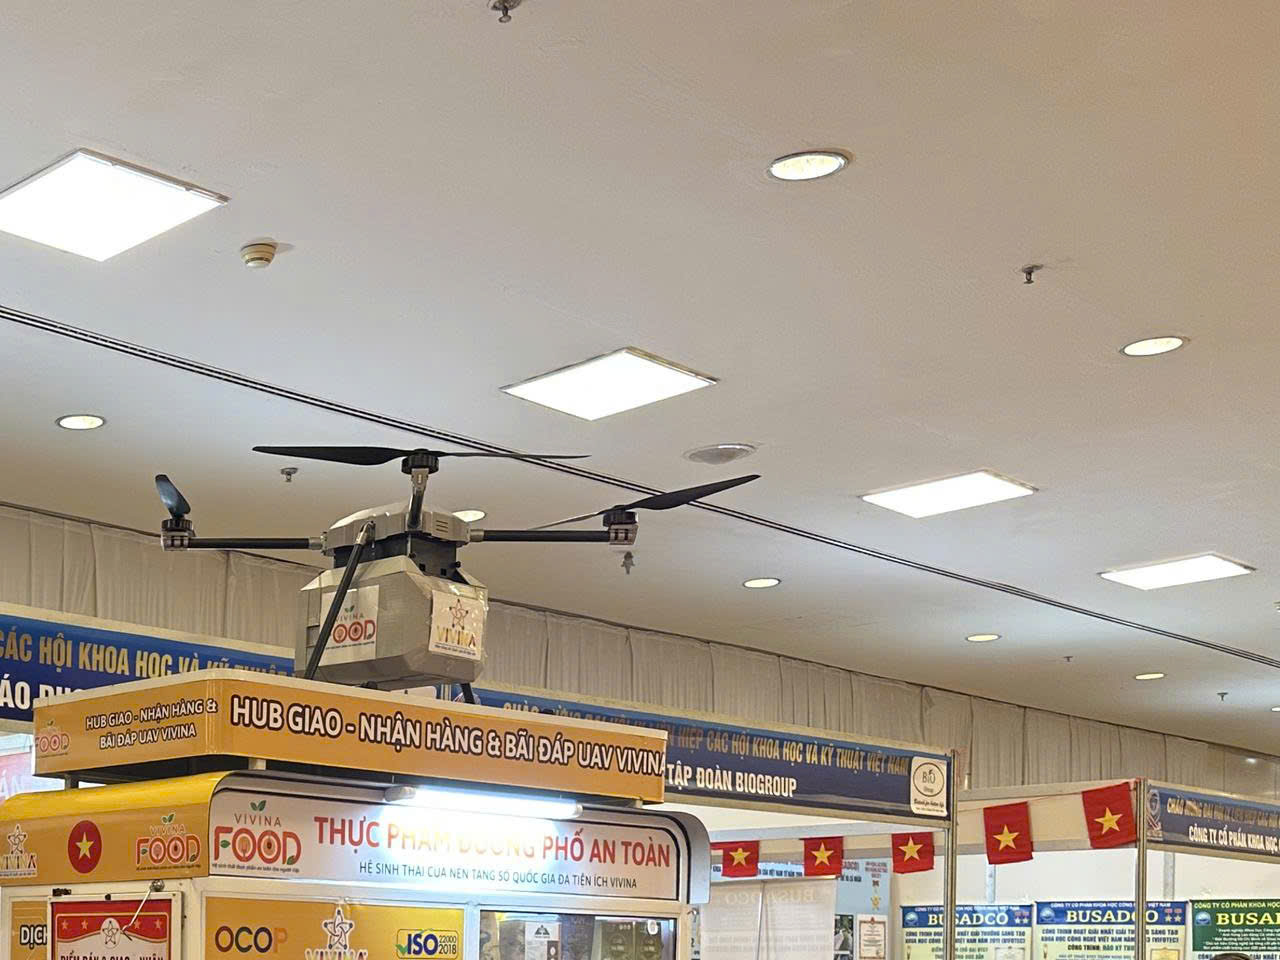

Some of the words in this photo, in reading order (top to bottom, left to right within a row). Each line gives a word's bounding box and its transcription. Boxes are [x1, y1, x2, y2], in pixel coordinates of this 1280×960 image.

[332, 619, 376, 644] OOD
[39, 633, 72, 672] HỘI
[79, 642, 129, 677] KHOA
[86, 714, 107, 731] HUB
[107, 710, 132, 728] GIAO
[139, 703, 170, 724] NHẬN
[172, 698, 203, 721] HÀNG
[206, 699, 218, 714] &
[100, 733, 116, 749] BÃI
[117, 729, 137, 747] ĐÁP
[138, 728, 160, 746] UAV
[161, 723, 196, 743] VIVINA
[232, 694, 283, 729] HUB
[287, 705, 342, 736] GIAO
[359, 713, 420, 752] NHẬN
[426, 717, 483, 755] HÀNG
[487, 733, 501, 757] &
[505, 729, 534, 762] BÃI
[538, 732, 574, 765] ĐÁP
[578, 742, 614, 770] UAV
[616, 747, 666, 776] VIVINA
[731, 730, 750, 760] HỘI
[752, 737, 780, 761] KHOA
[782, 741, 803, 766] HỌC
[805, 741, 819, 765] VÀ
[820, 743, 834, 768] KỸ
[836, 747, 866, 774] THUẬT
[667, 760, 692, 790] TẬP
[696, 765, 733, 792] ĐOÀN
[735, 774, 797, 798] BIOGROUP
[234, 813, 282, 828] VIVINA
[1188, 823, 1208, 843] CÔNG
[1209, 828, 1217, 844] TY
[136, 836, 201, 865] FOOD
[214, 826, 302, 865] FOOD
[314, 815, 380, 854] THỰC
[542, 828, 585, 862] PHỐ
[589, 838, 616, 865] AN
[620, 836, 671, 868] TOÀN
[375, 863, 399, 876] SINH
[541, 872, 556, 885] GIA
[558, 873, 570, 886] ĐA
[593, 873, 609, 888] ÍCH
[610, 875, 637, 889] VIVINA
[215, 926, 287, 953] OCOP
[408, 933, 438, 956] ISO
[439, 935, 457, 944] 22000
[438, 944, 457, 955] 2018
